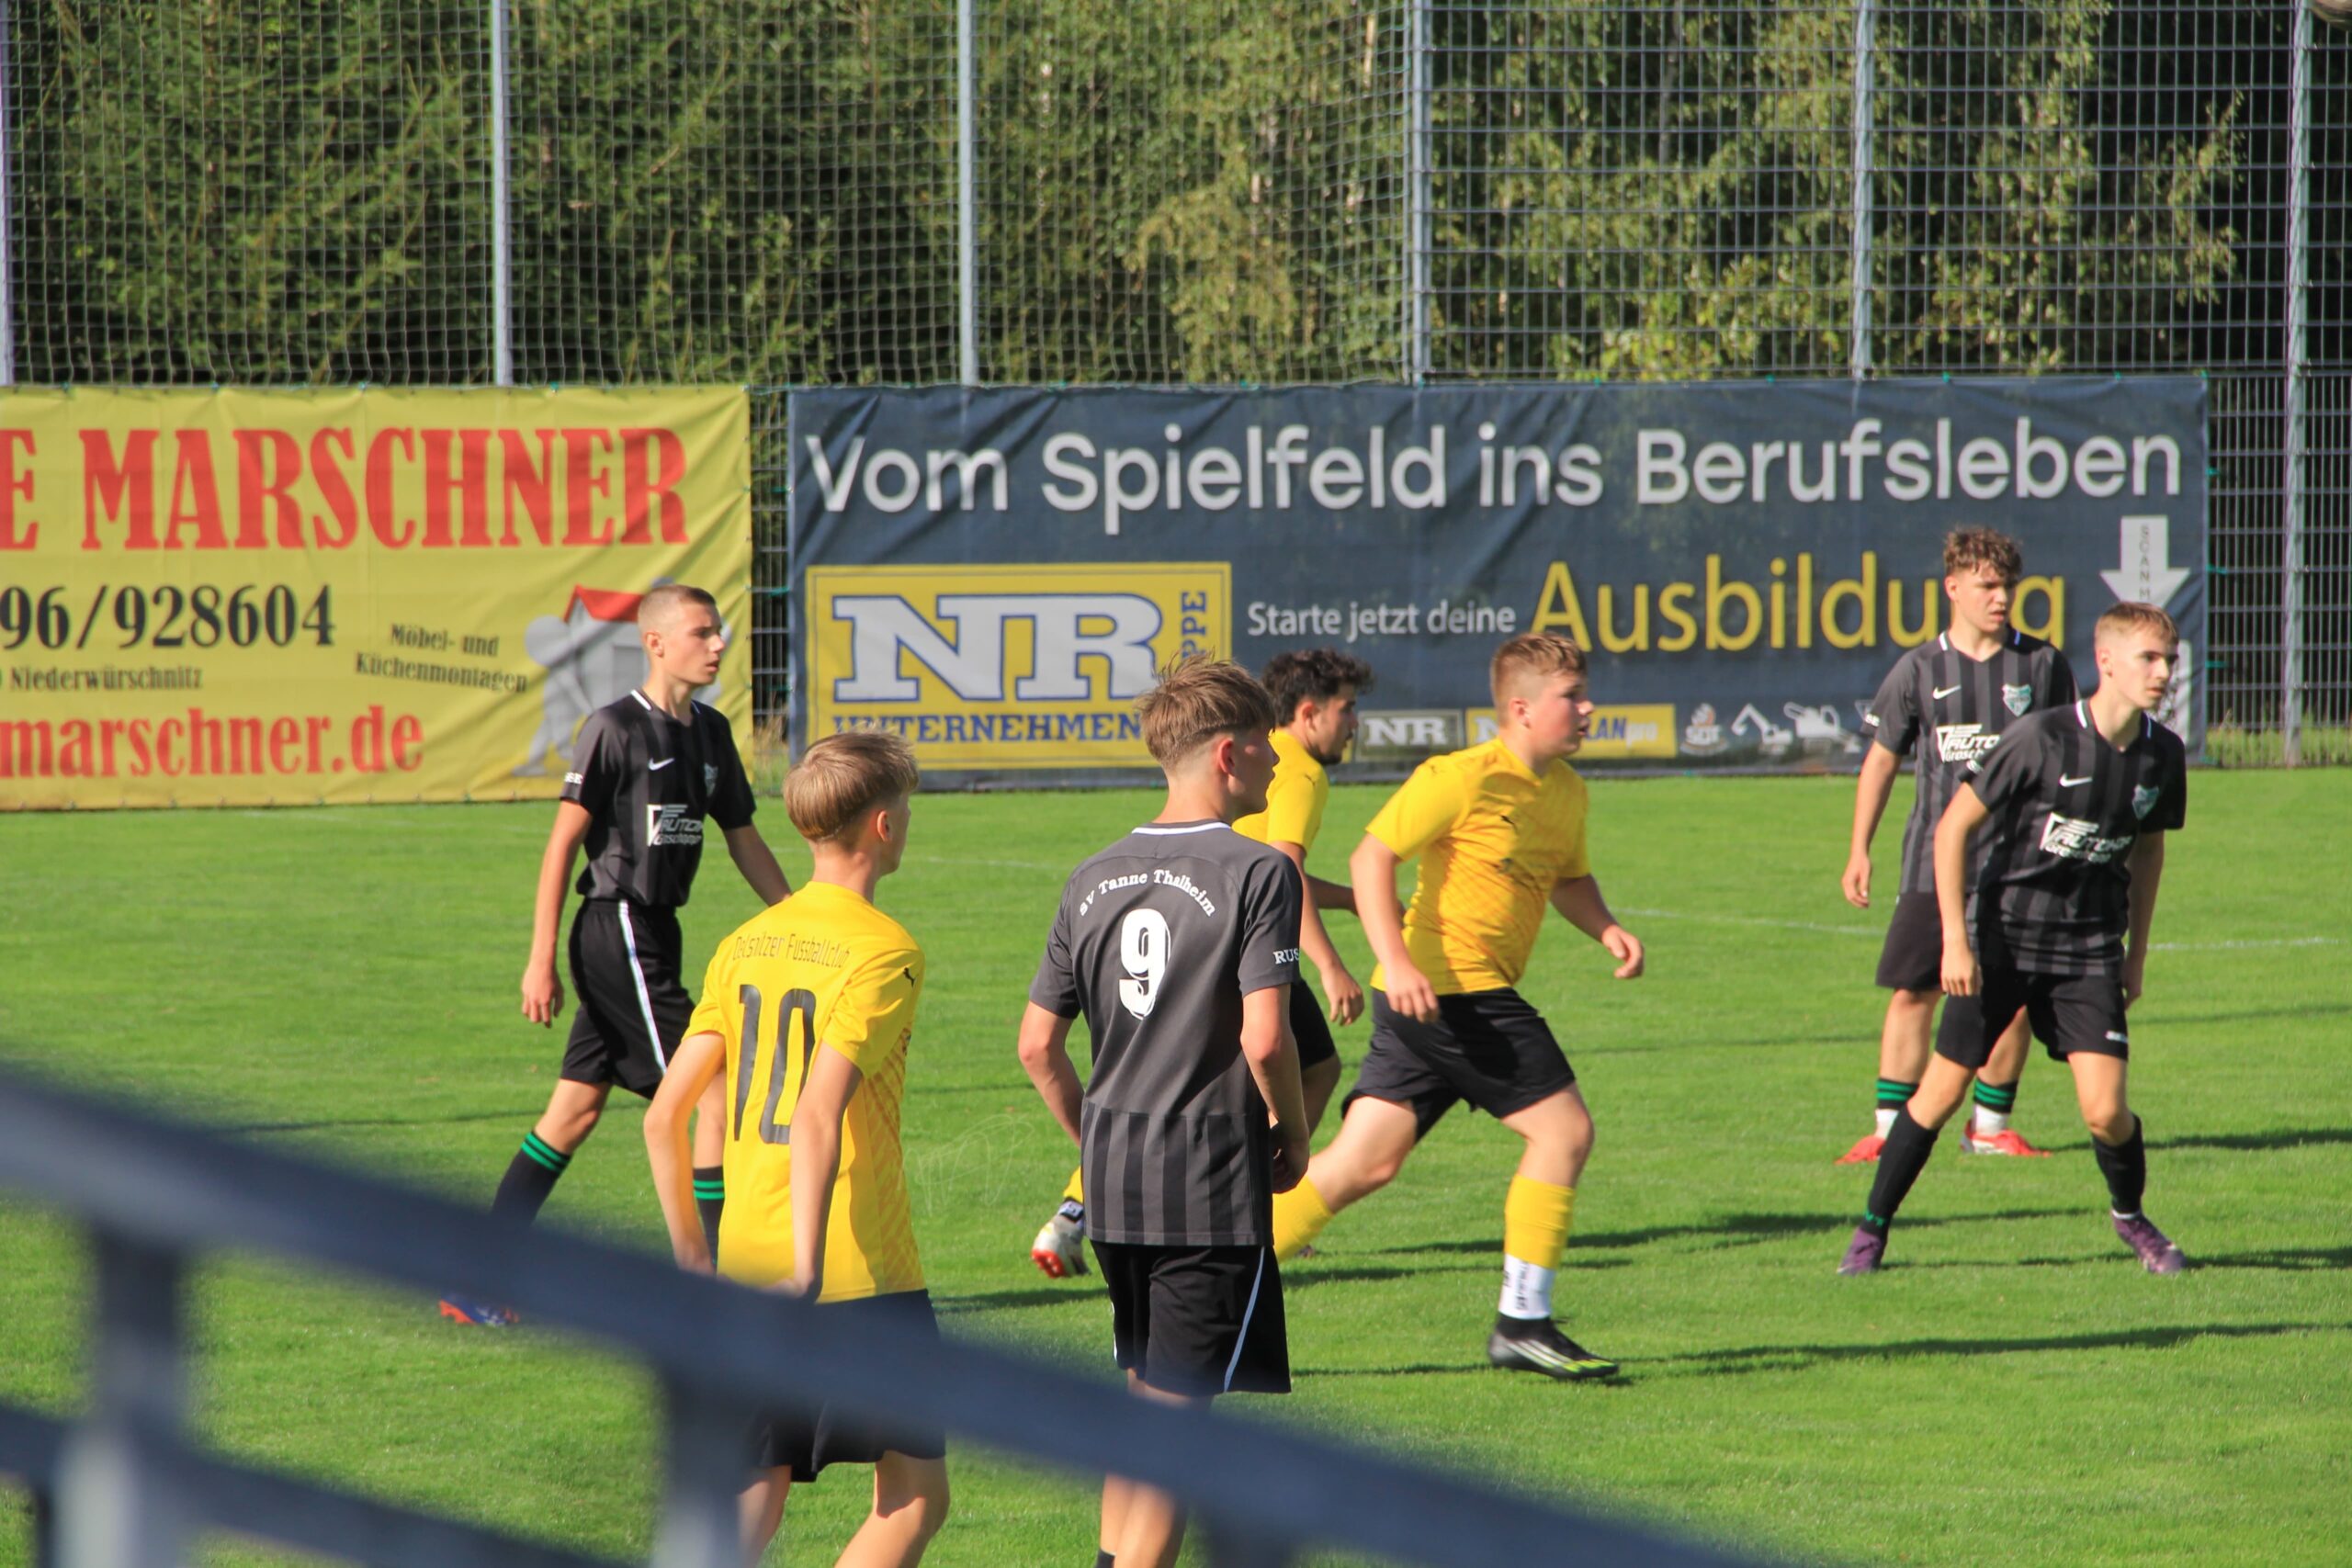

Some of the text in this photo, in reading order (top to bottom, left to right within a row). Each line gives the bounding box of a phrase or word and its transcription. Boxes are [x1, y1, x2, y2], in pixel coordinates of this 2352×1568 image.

[78, 427, 689, 550] MARSCHNER
[805, 416, 2181, 536] Vom Spielfeld ins Berufsleben
[0, 584, 336, 649] 96/928604
[1248, 599, 1516, 644] Starte jetzt deine
[1532, 551, 2066, 653] Ausbildug
[355, 650, 528, 694] Küchenmontagen
[390, 623, 499, 658] Möbel- und
[831, 592, 1163, 701] NR
[10, 665, 204, 692] Niederwürschnitz
[1364, 716, 1448, 746] NR
[1098, 873, 1148, 896] Tanne
[1153, 869, 1216, 918] Thalheim
[1118, 908, 1171, 1021] 9
[734, 984, 817, 1145] 10
